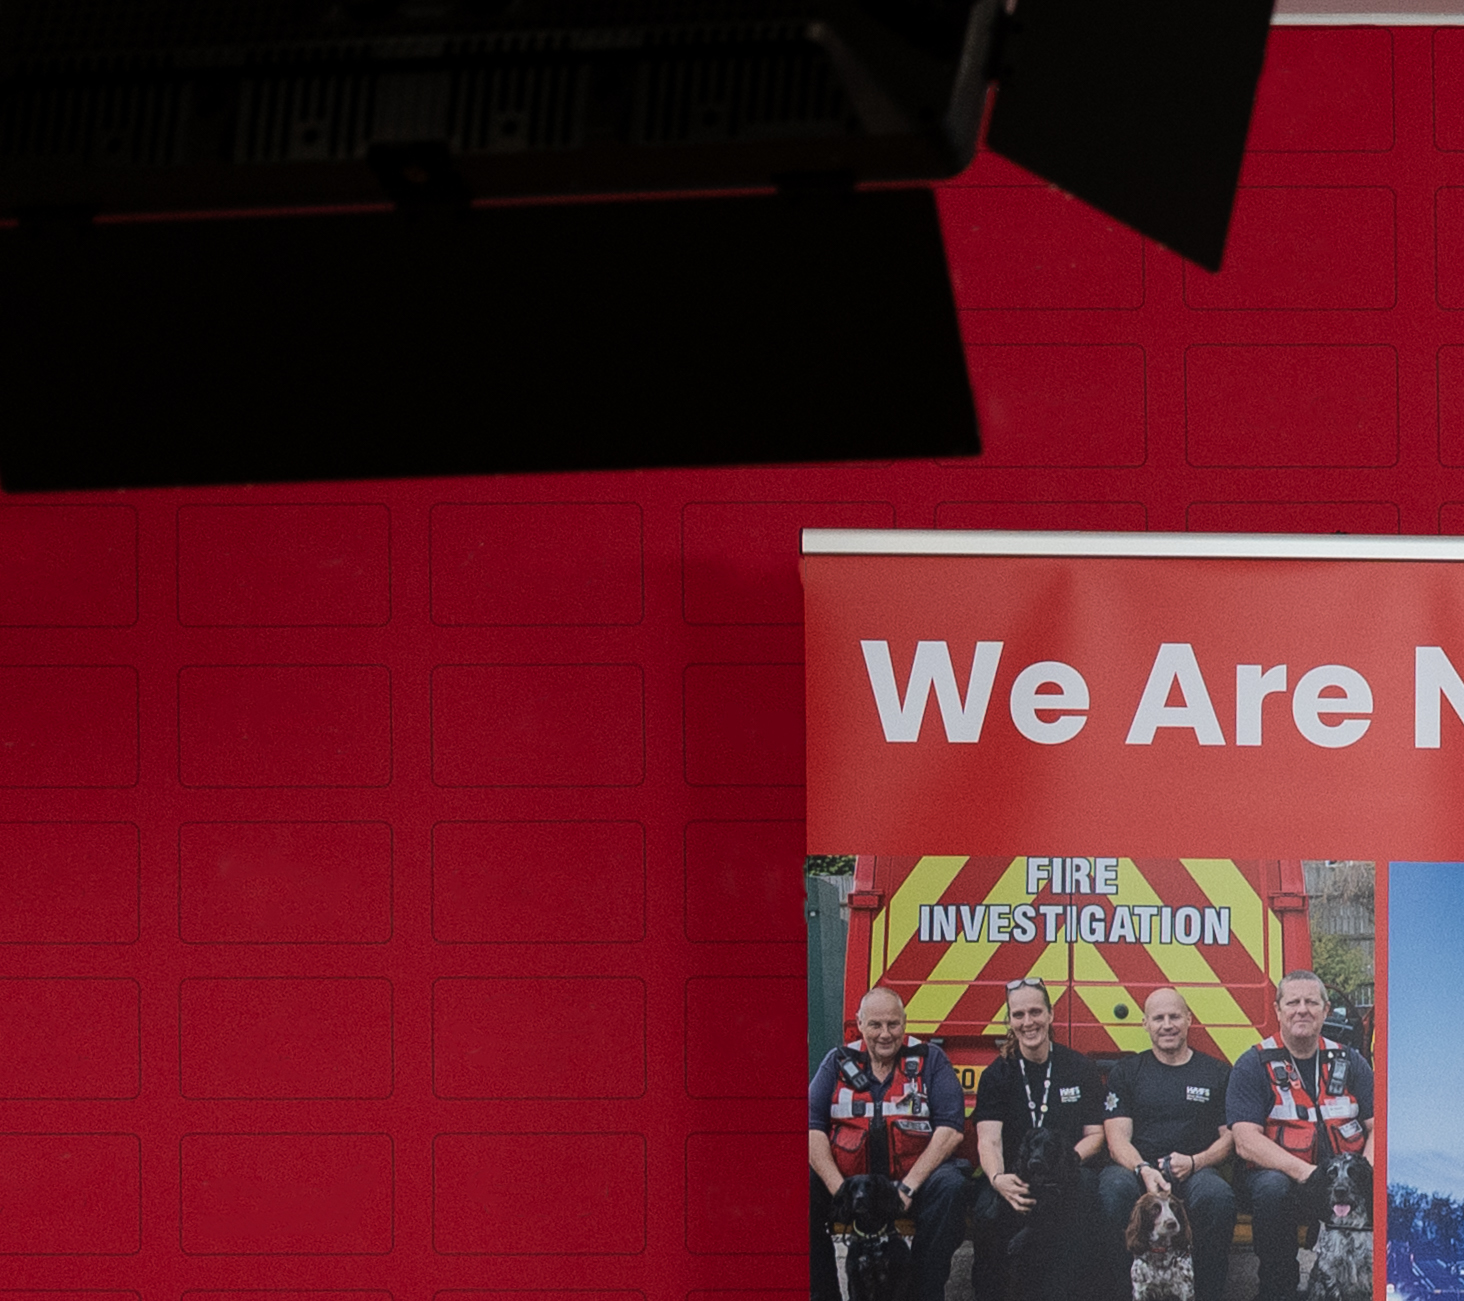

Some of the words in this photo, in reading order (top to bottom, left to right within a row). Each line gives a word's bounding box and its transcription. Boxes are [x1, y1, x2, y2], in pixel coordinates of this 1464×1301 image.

[860, 639, 1090, 744] We
[1125, 641, 1373, 748] Are
[1026, 857, 1118, 894] FIRE
[918, 904, 1230, 945] INVESTIGATION
